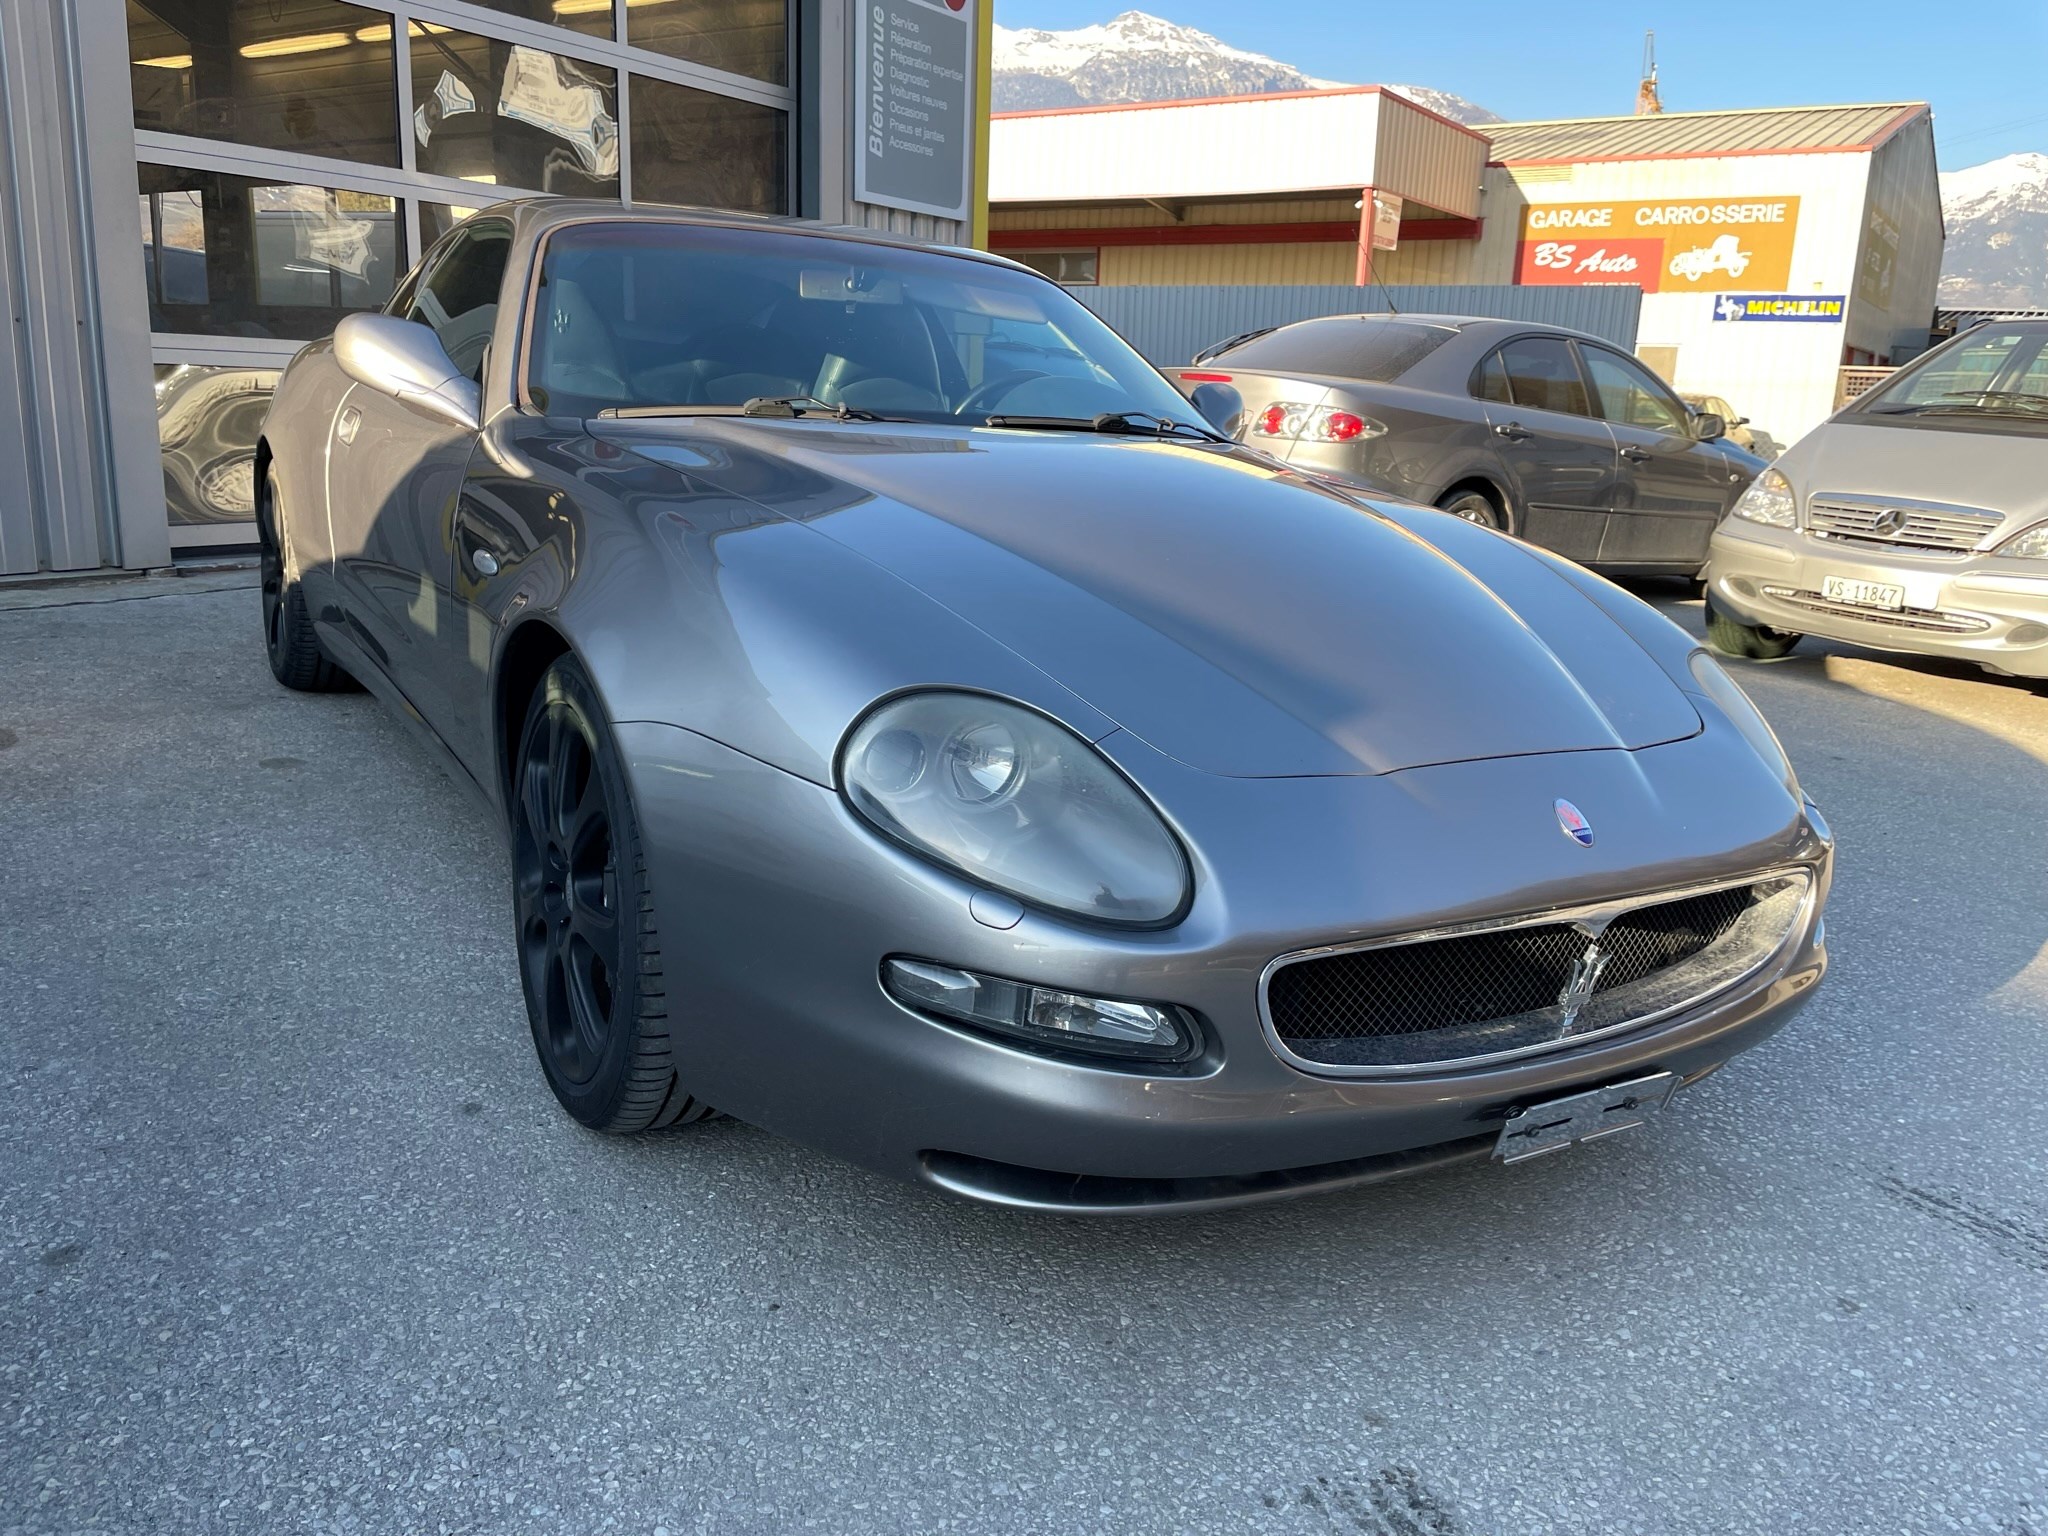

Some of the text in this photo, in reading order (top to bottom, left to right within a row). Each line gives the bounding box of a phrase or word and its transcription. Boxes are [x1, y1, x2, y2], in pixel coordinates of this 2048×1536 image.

[890, 13, 920, 33] Service
[890, 31, 932, 55] Réparation
[890, 48, 964, 82] Préparation expertise
[890, 66, 930, 88] Diagnostic
[869, 5, 885, 158] Bienvenue
[889, 83, 948, 110] Voitures neuves
[889, 101, 929, 122] Occasions
[889, 117, 945, 143] Pneus et jantes
[888, 135, 934, 157] Accessoires
[1529, 203, 1787, 229] GARAGE CARROSSERIE
[1534, 242, 1638, 274] BS Auto
[1746, 300, 1842, 316] MICHELIN
